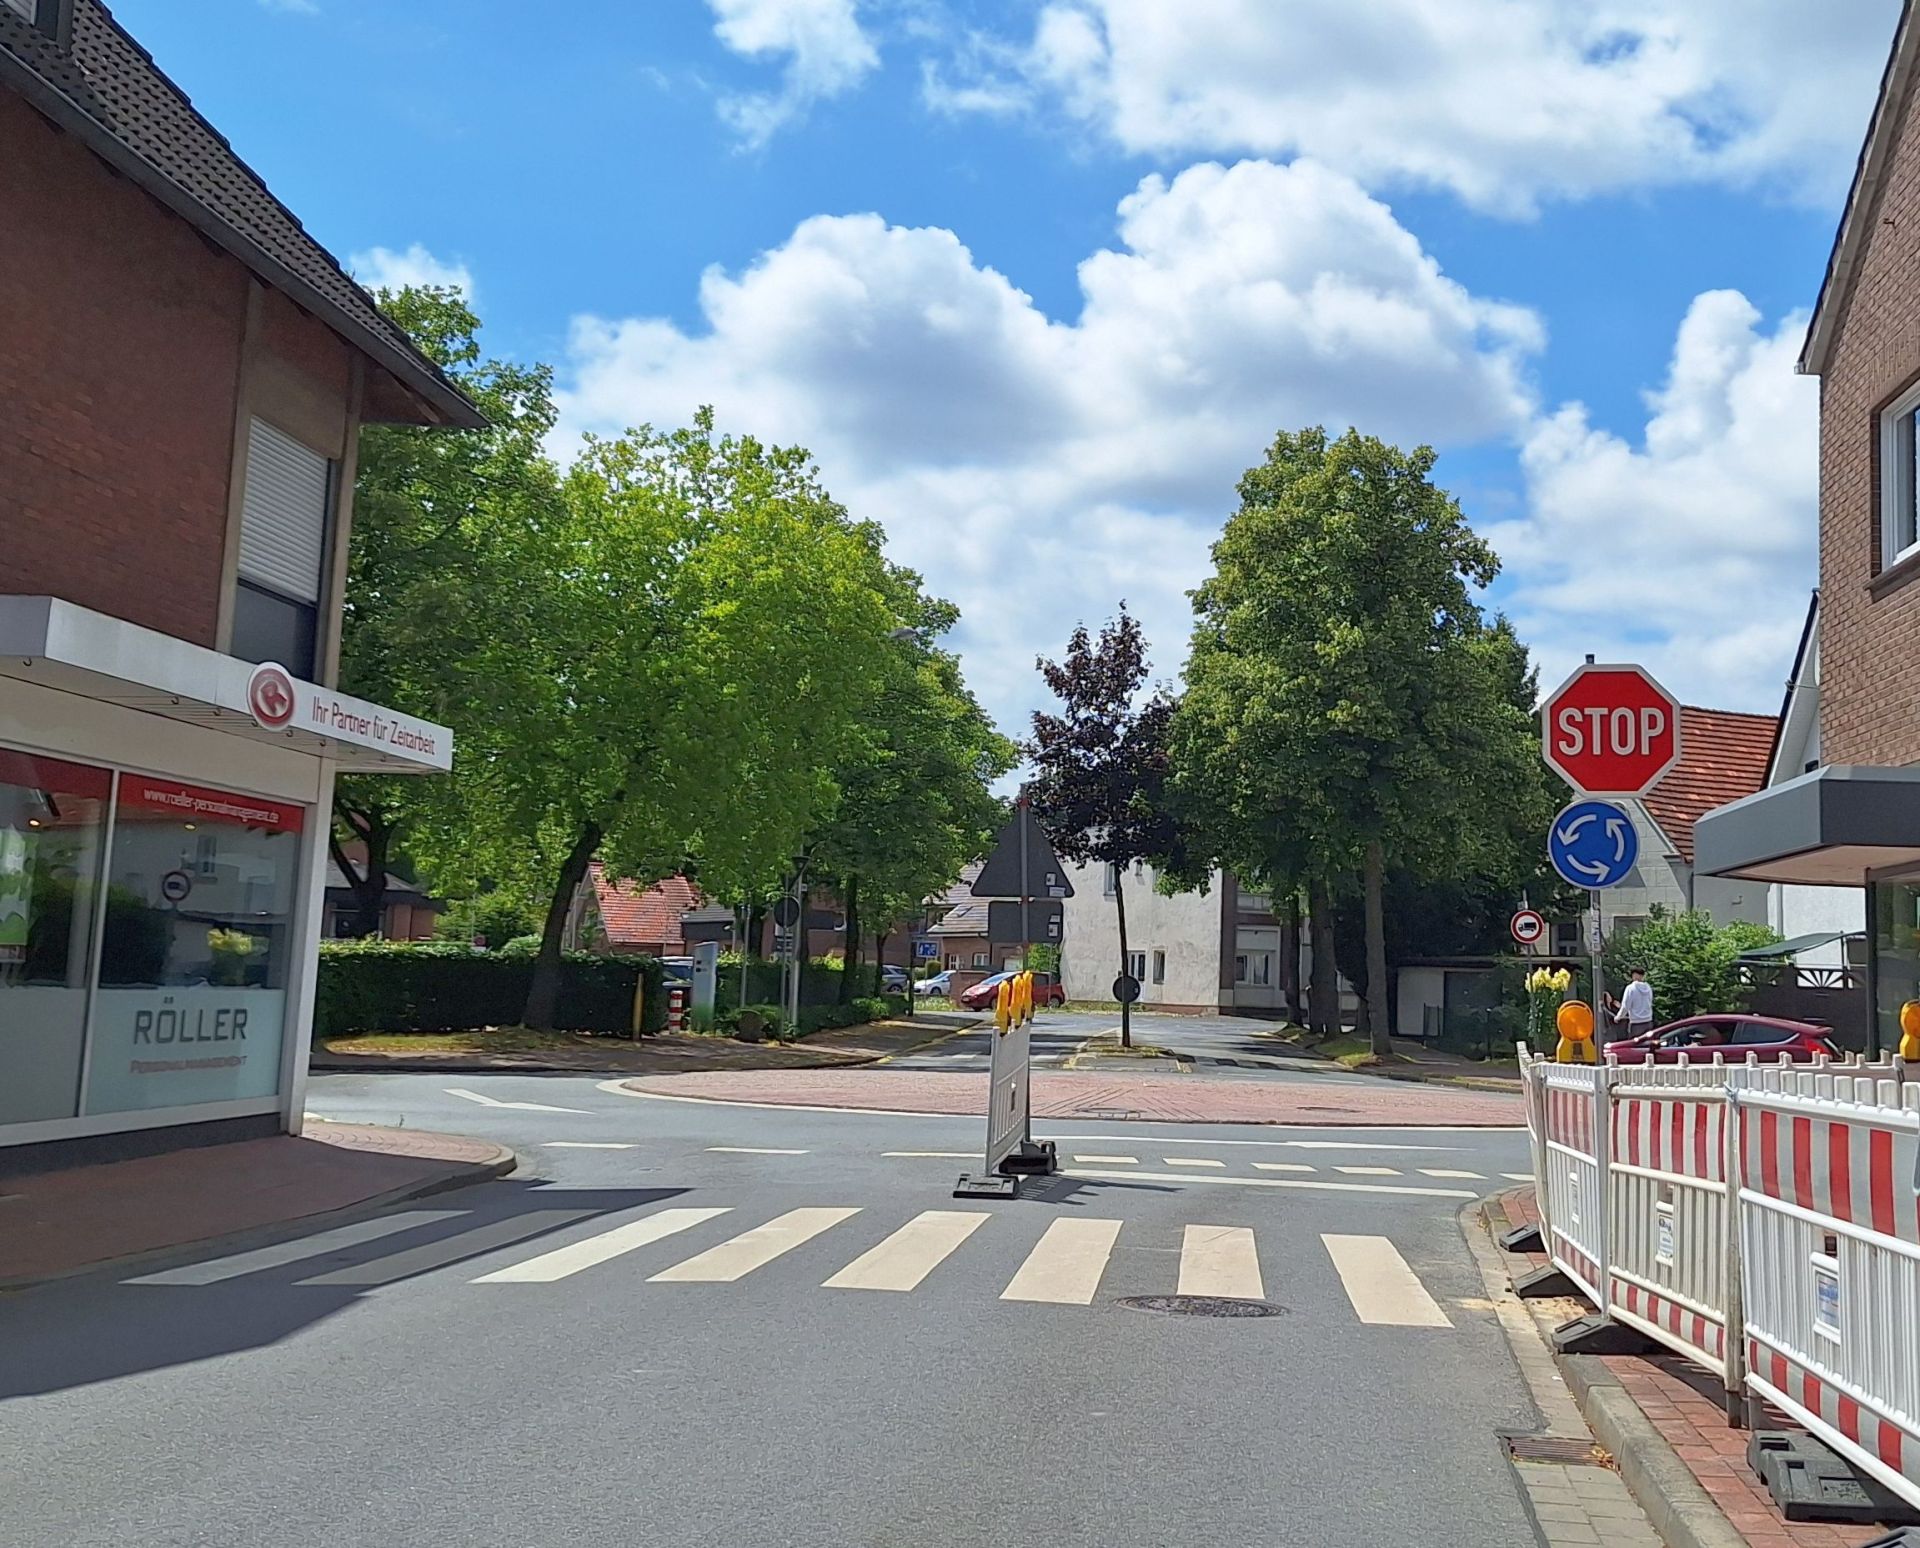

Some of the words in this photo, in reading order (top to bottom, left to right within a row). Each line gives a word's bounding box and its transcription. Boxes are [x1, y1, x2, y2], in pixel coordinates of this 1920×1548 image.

[312, 696, 329, 724] Ihr
[331, 702, 371, 732] Partner
[373, 715, 388, 741] für
[390, 720, 436, 756] Zeitarbeit
[1559, 707, 1665, 756] STOP
[133, 996, 248, 1045] RÖLLER
